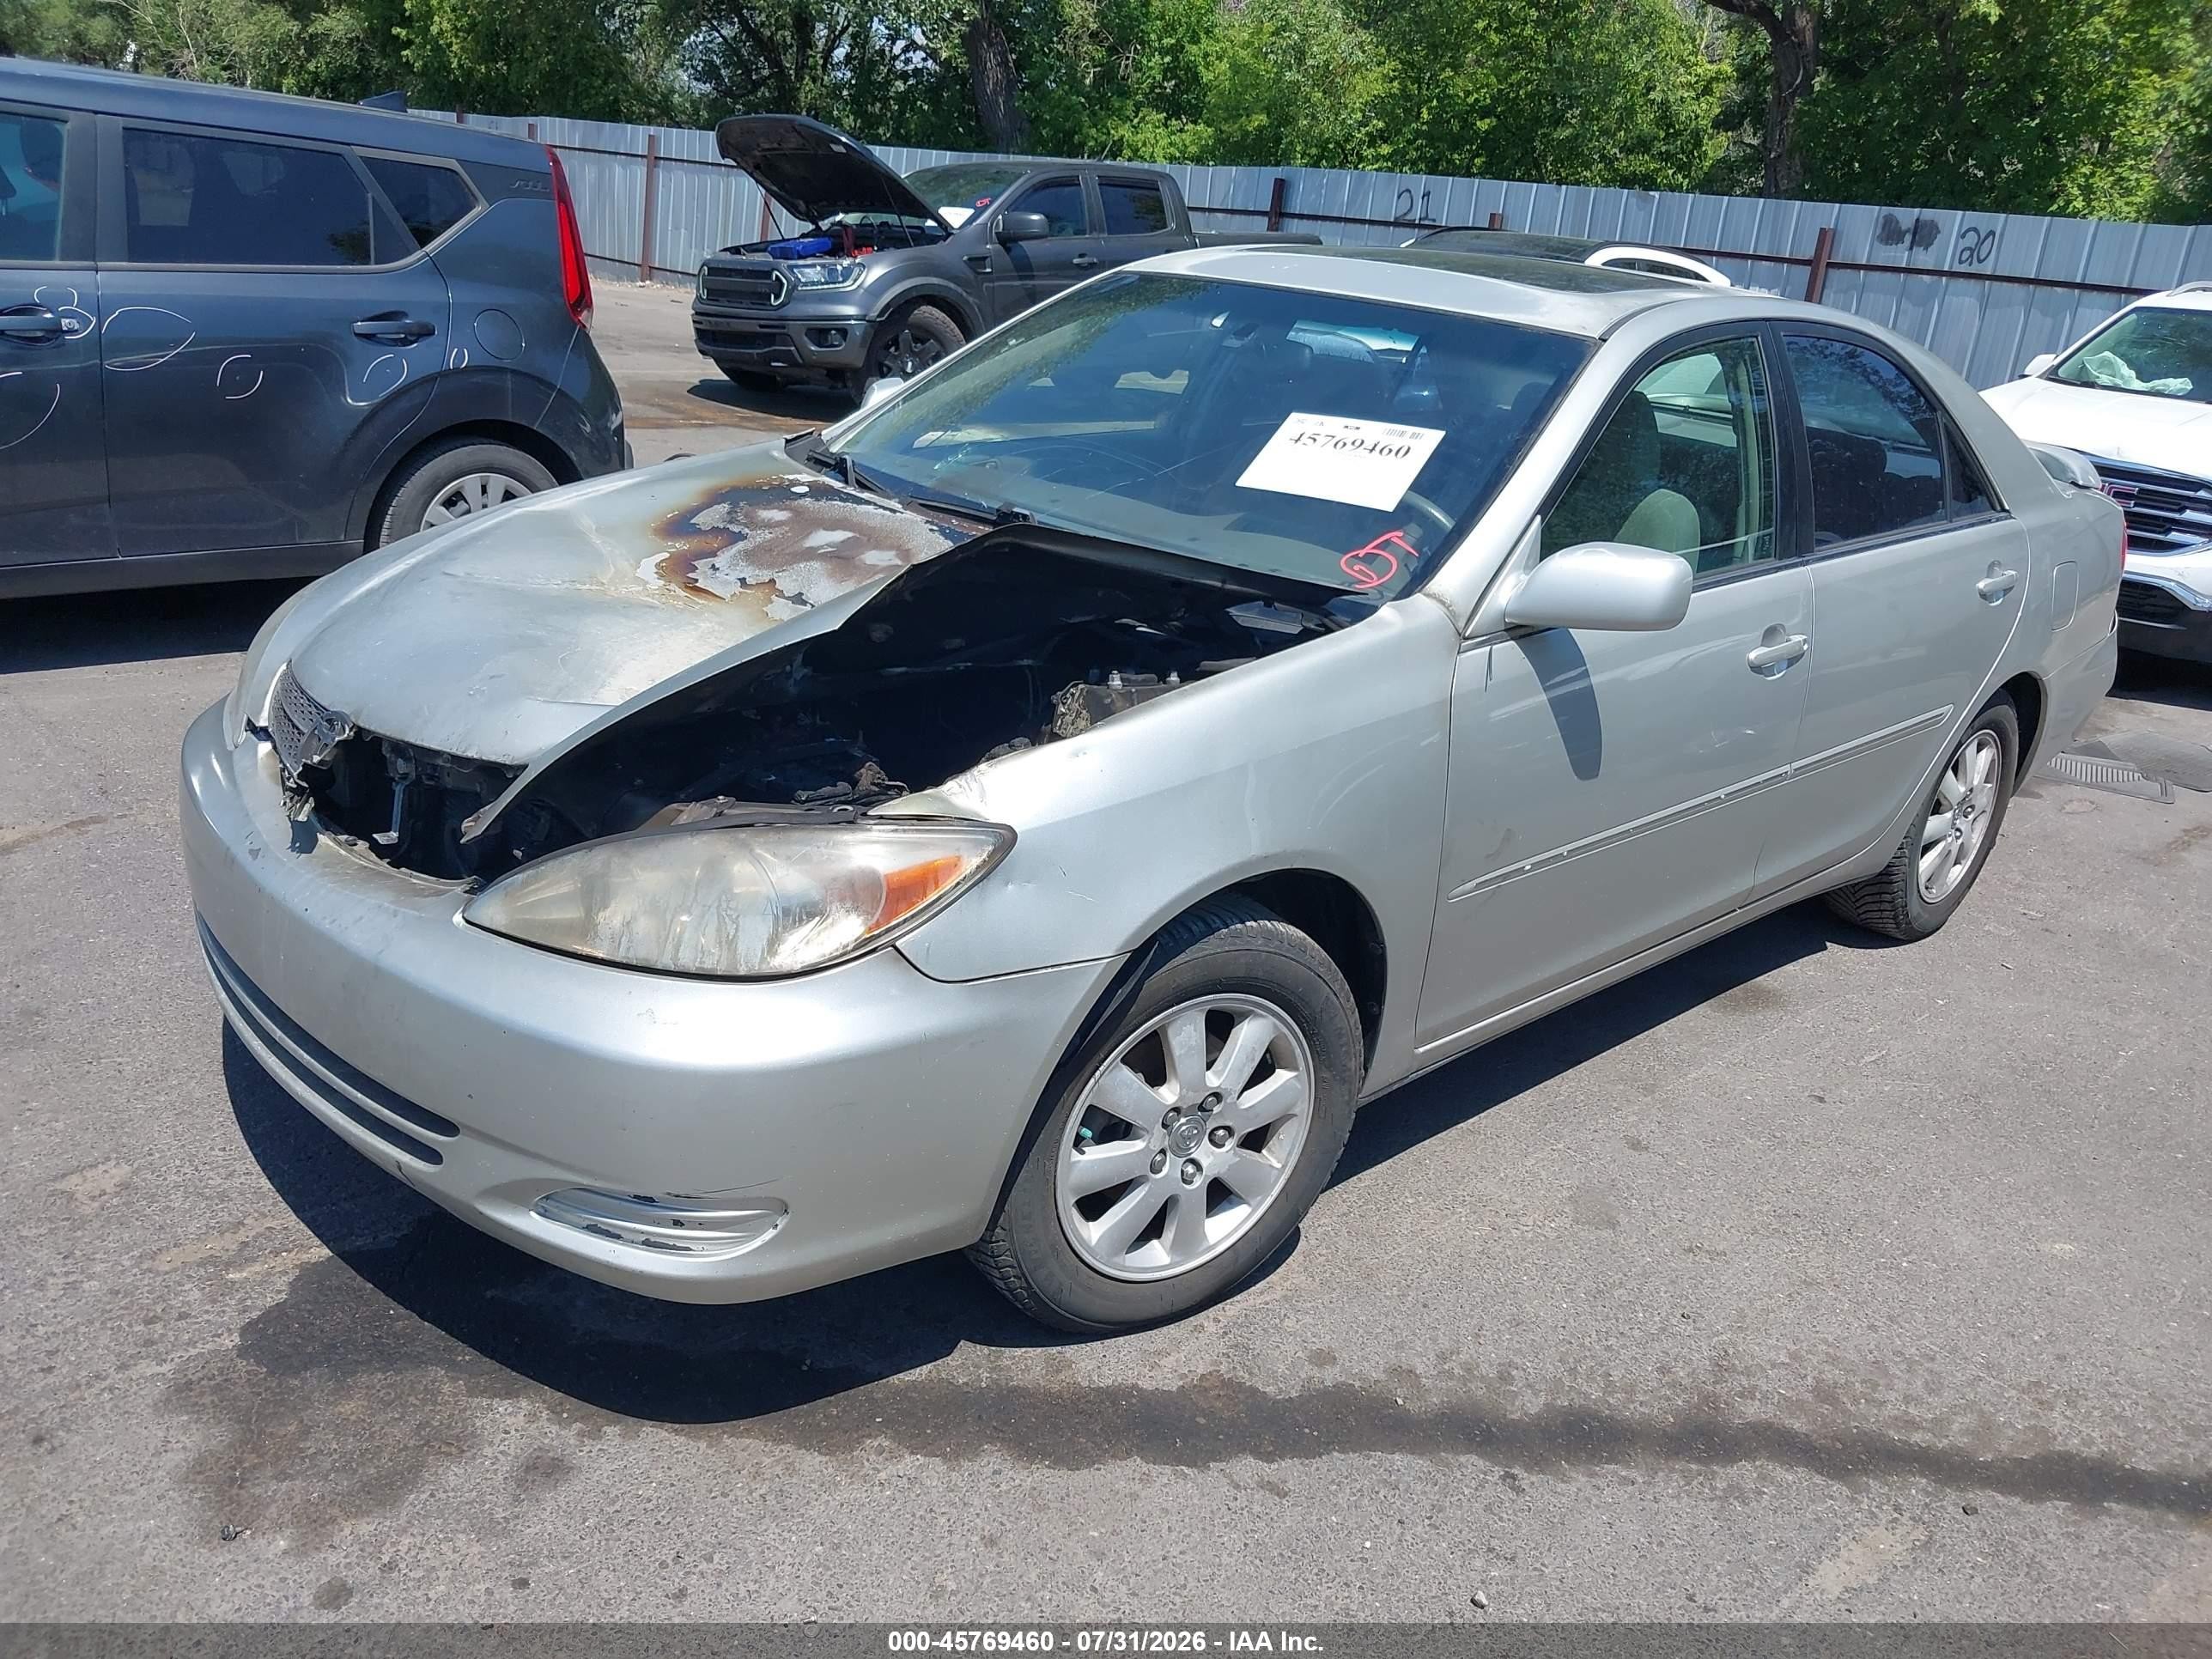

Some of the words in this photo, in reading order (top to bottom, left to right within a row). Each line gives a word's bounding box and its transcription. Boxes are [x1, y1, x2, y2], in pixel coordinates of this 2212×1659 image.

[1394, 188, 1437, 222] 21
[1958, 226, 1996, 266] 20
[1289, 431, 1412, 459] 45769460
